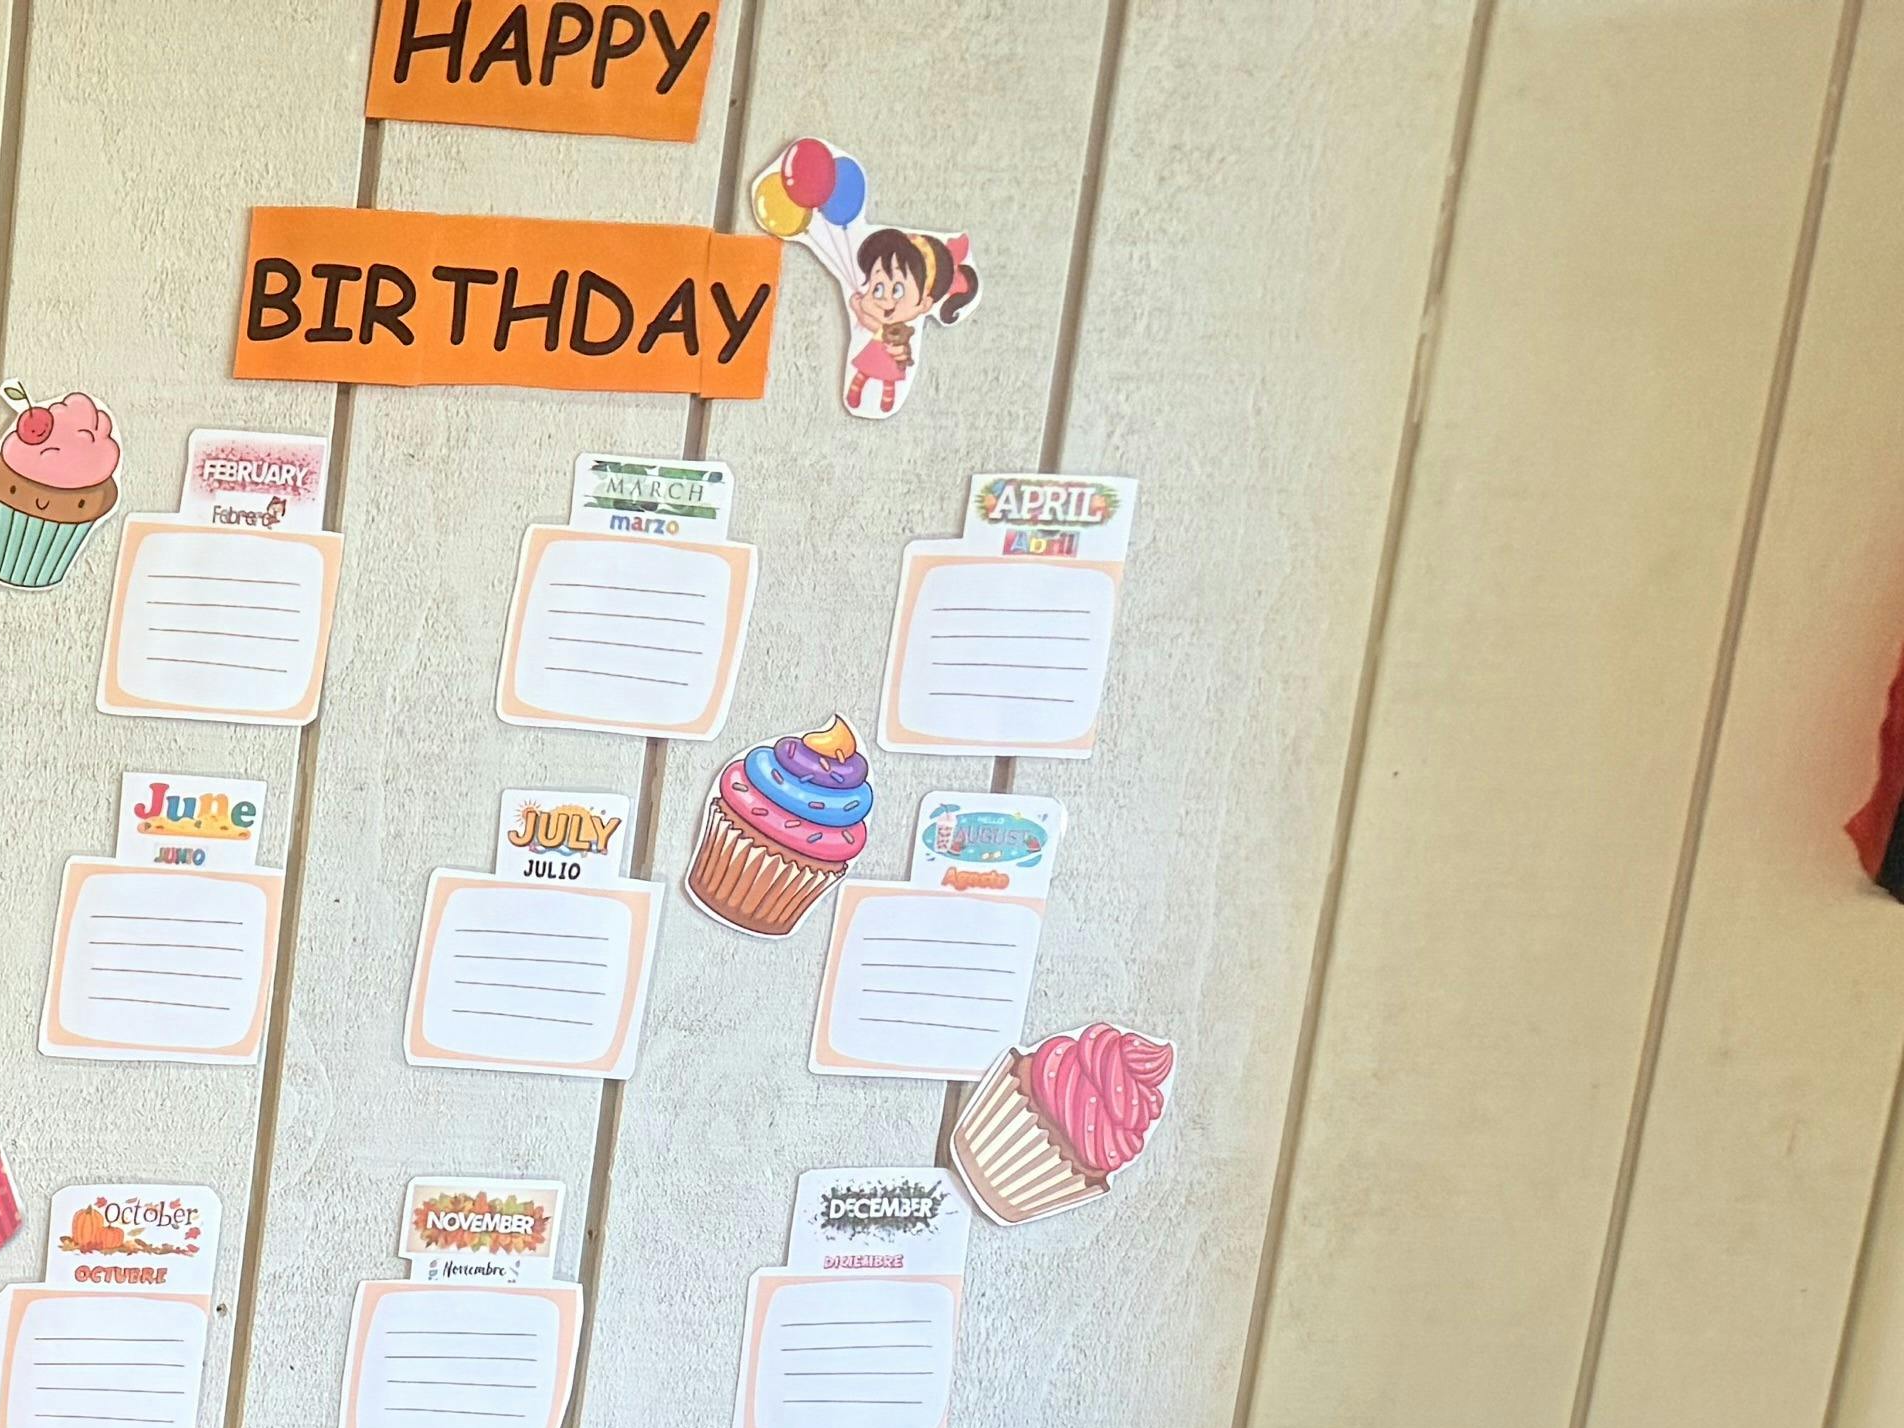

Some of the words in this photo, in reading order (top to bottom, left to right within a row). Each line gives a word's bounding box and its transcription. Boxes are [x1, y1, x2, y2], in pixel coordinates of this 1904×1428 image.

[391, 0, 712, 95] HAPPY
[246, 256, 772, 366] BIRTHDAY
[202, 457, 309, 488] FEBRUARY
[605, 475, 705, 503] MARCH
[987, 483, 1106, 523] APRIL
[608, 510, 681, 536] marzo
[134, 781, 257, 830] June
[507, 804, 624, 853] JULY
[956, 824, 1031, 845] AUGUST
[154, 847, 206, 867] JUNIO
[523, 859, 582, 882] JULIO
[103, 1196, 199, 1230] October
[426, 1208, 537, 1237] NOVEMBER
[828, 1195, 934, 1222] DECEMBER
[73, 1265, 169, 1287] OCTUBRE
